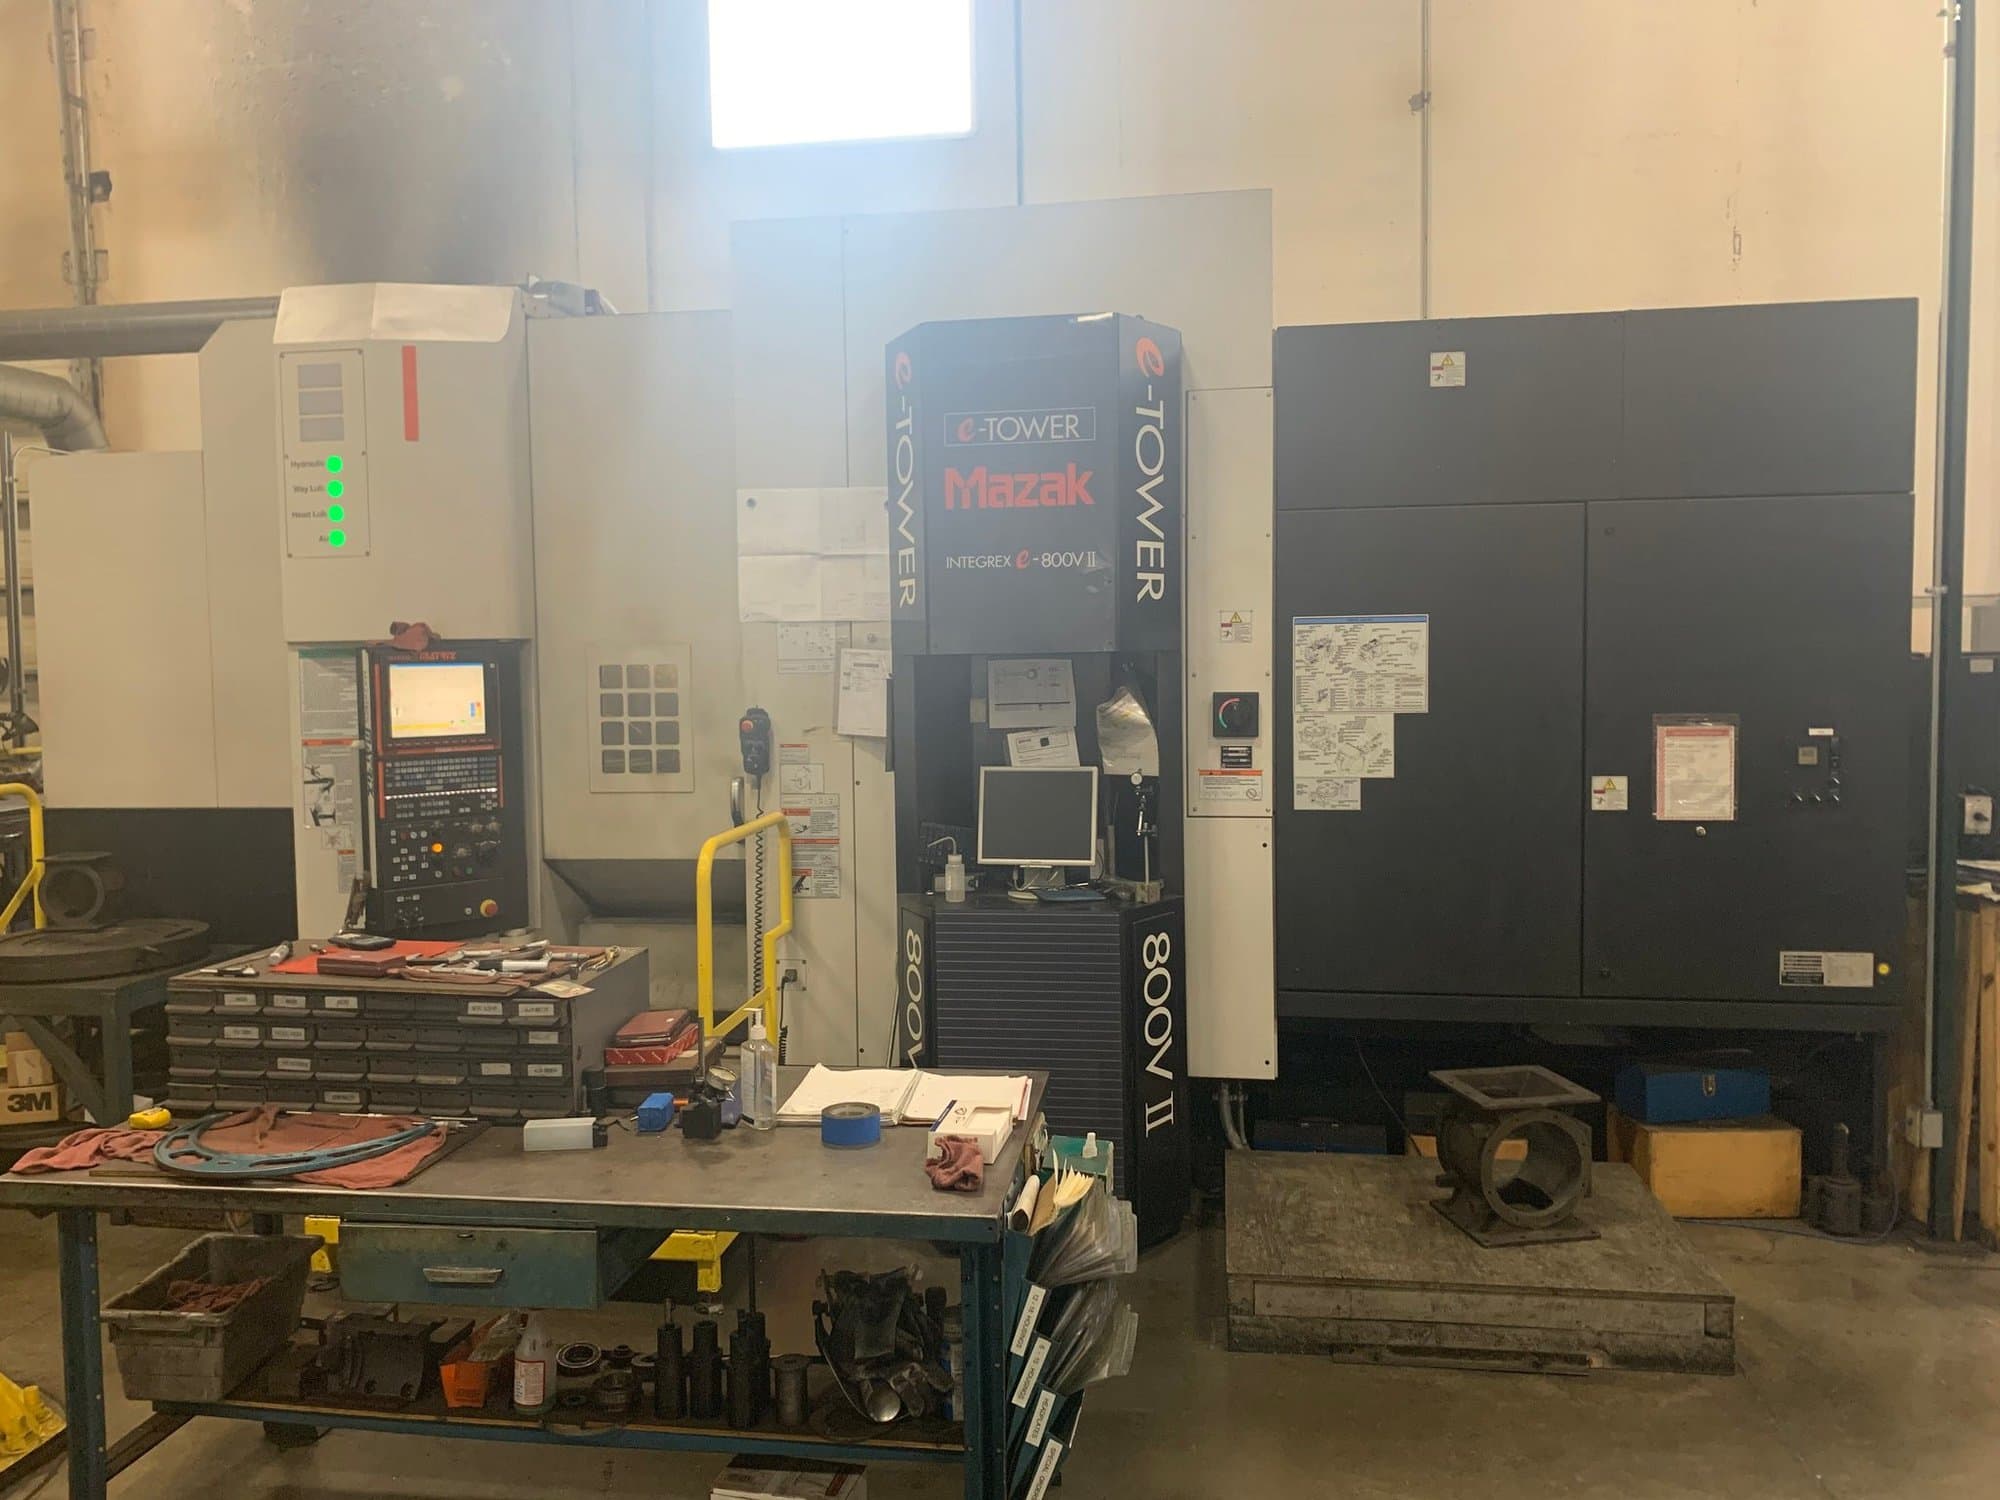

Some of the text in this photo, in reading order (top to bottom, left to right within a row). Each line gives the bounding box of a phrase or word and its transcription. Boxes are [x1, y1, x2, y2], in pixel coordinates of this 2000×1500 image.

[943, 462, 1096, 510] Mazak
[946, 555, 1012, 569] INTEGREX
[1142, 931, 1174, 1081] 800V
[7, 1091, 52, 1113] 3M
